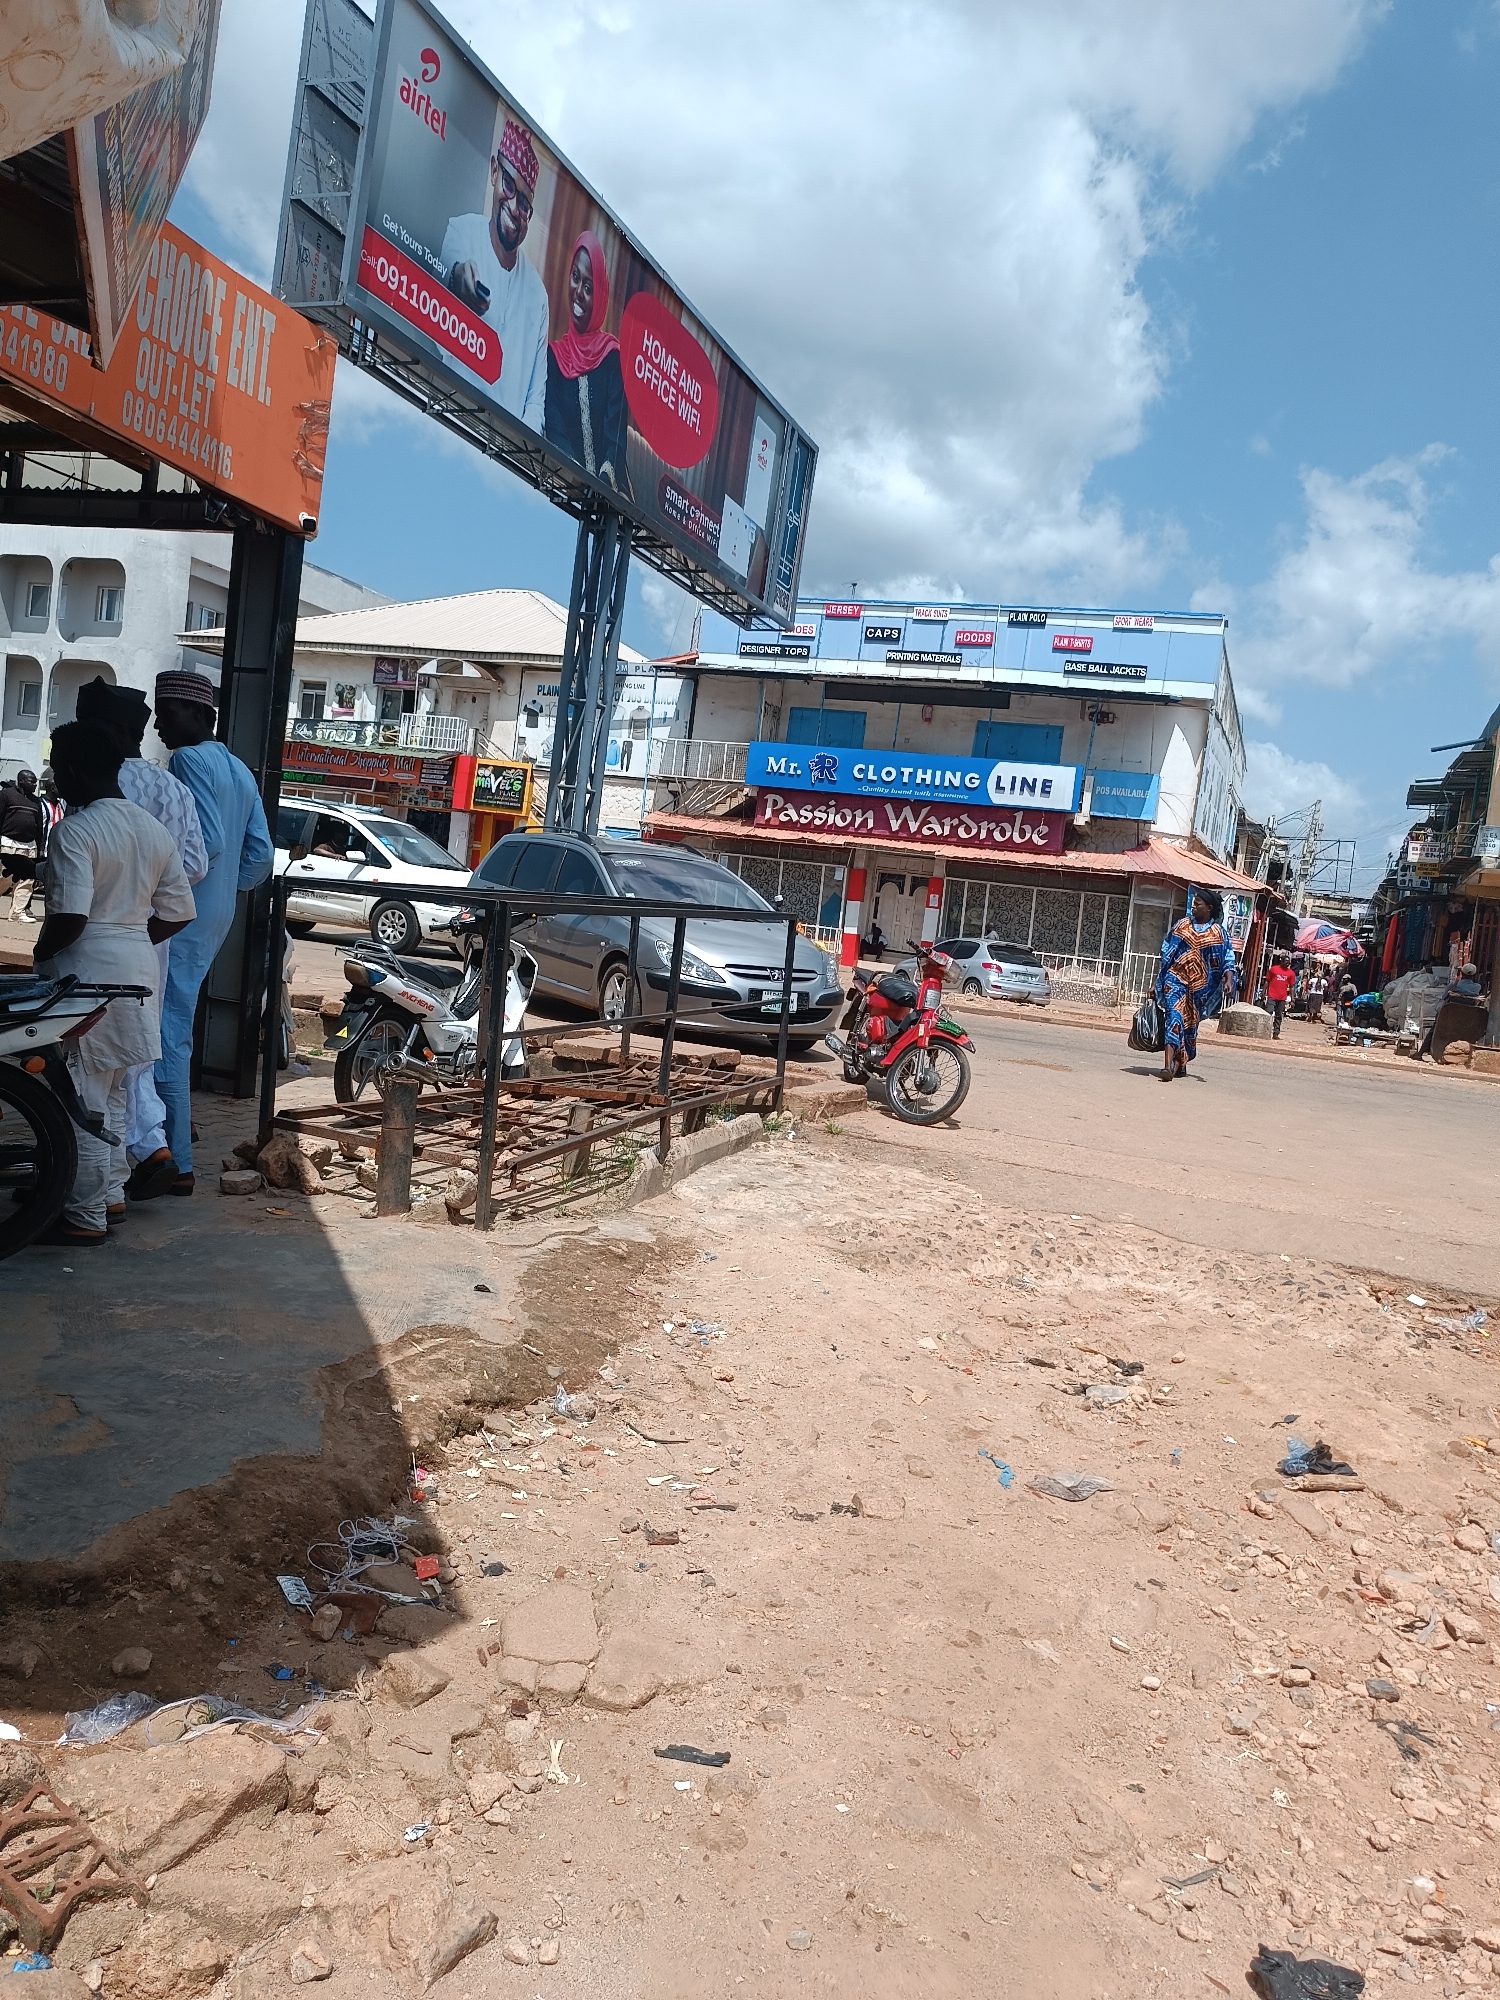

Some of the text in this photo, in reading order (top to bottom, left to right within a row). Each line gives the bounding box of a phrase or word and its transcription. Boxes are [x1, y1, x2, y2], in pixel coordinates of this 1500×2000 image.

[400, 77, 446, 141] airtel
[383, 214, 448, 278] Get Yours Today
[361, 249, 377, 270] Call:
[377, 256, 486, 361] 09110000080
[136, 238, 227, 374] CHOICE
[226, 290, 277, 406] ENT.
[643, 329, 702, 404] HOME AND
[135, 336, 216, 428] OUT-LET
[634, 354, 701, 436] OFFICE WIFI.
[121, 390, 234, 481] 08064444116.
[665, 485, 690, 514] smart
[664, 501, 681, 520] Home
[688, 520, 705, 538] Office
[826, 604, 860, 615] JERSEY
[915, 608, 948, 618] TRACK SUITS
[1009, 612, 1046, 623] PLAIN POLO
[1114, 616, 1153, 628] SPORT WEARS
[866, 628, 899, 639] CAPS
[956, 632, 991, 643] HOODS
[1053, 637, 1092, 649] PLAIN T-SHIRTS
[741, 644, 808, 656] DESIGNER TOPS
[886, 651, 961, 664] PRINTING MATERIALS
[1065, 662, 1147, 677] BASE BALL JACKETS
[296, 744, 349, 766] International
[350, 751, 390, 777] Shopping
[394, 756, 416, 772] Mall
[283, 772, 305, 781] silver
[766, 756, 801, 775] Mr.
[853, 763, 980, 788] CLOTHING
[994, 775, 1053, 798] LINE
[1095, 785, 1150, 799] POS AVAILABLE
[763, 793, 1049, 847] Passion Wardrobe
[398, 990, 435, 1012] JINCHENG
